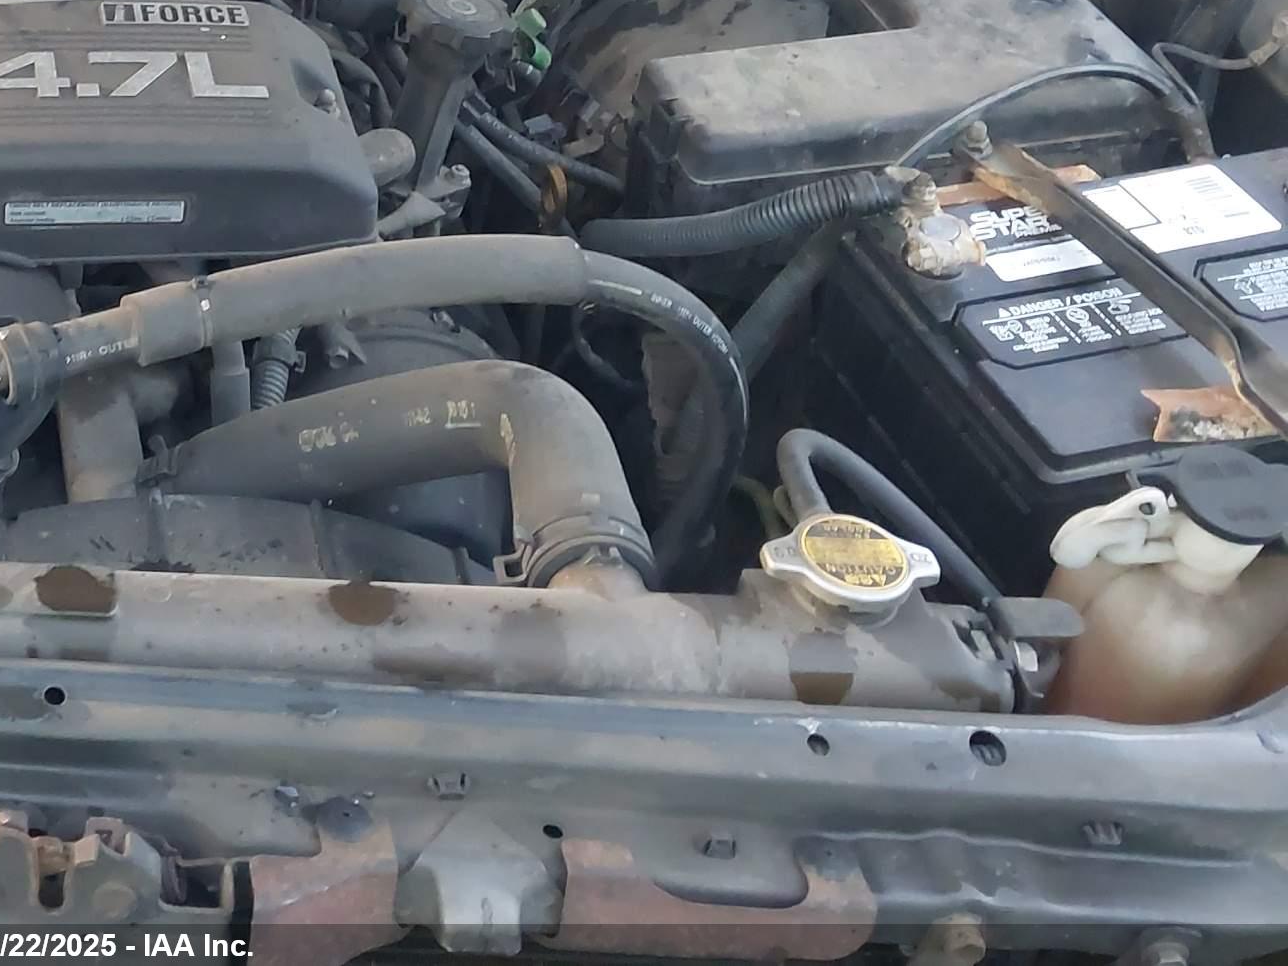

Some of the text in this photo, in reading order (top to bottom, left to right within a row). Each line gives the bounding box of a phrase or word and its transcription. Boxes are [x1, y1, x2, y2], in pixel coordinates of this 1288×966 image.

[969, 205, 1043, 225] SUPE
[969, 215, 1050, 242] STAR
[1009, 298, 1064, 316] DANGER
[1072, 287, 1124, 304] POISON
